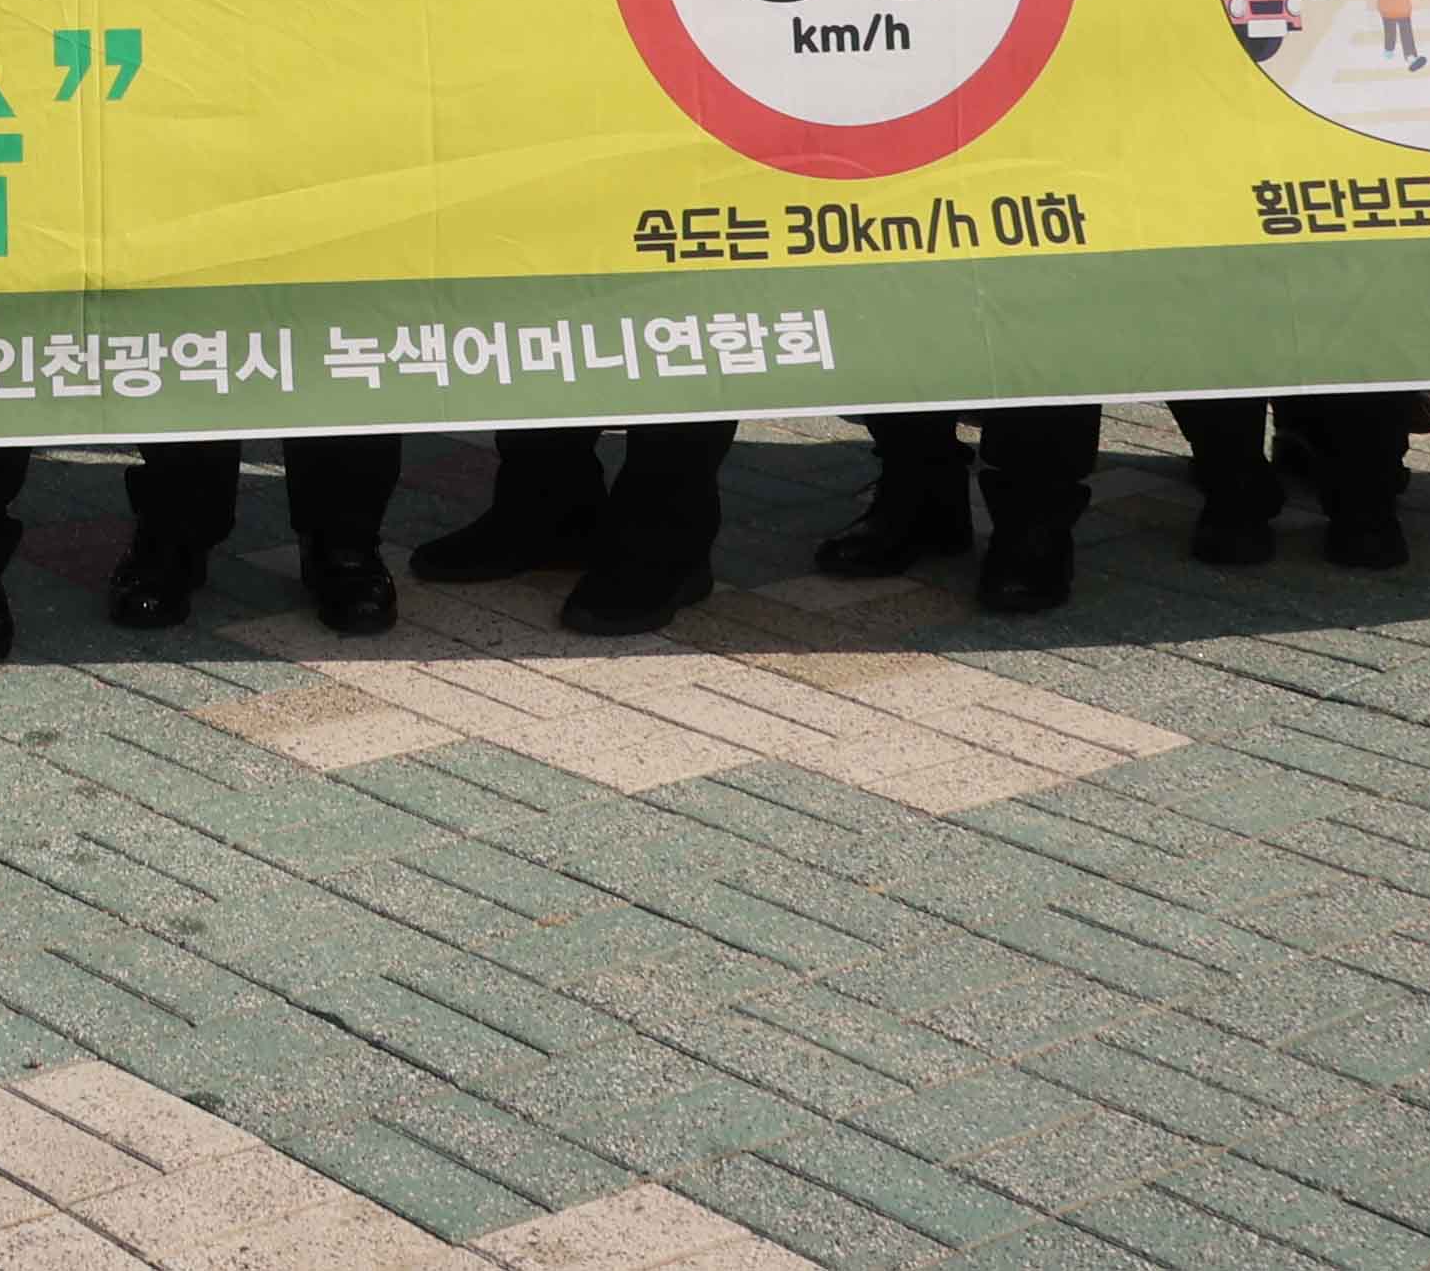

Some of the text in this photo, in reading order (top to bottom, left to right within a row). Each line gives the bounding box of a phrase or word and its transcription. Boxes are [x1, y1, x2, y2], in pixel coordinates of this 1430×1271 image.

[792, 12, 911, 57] km/h
[634, 192, 1086, 265] 속도는 30km/h 이하
[323, 309, 834, 392] 녹색어머니연합회
